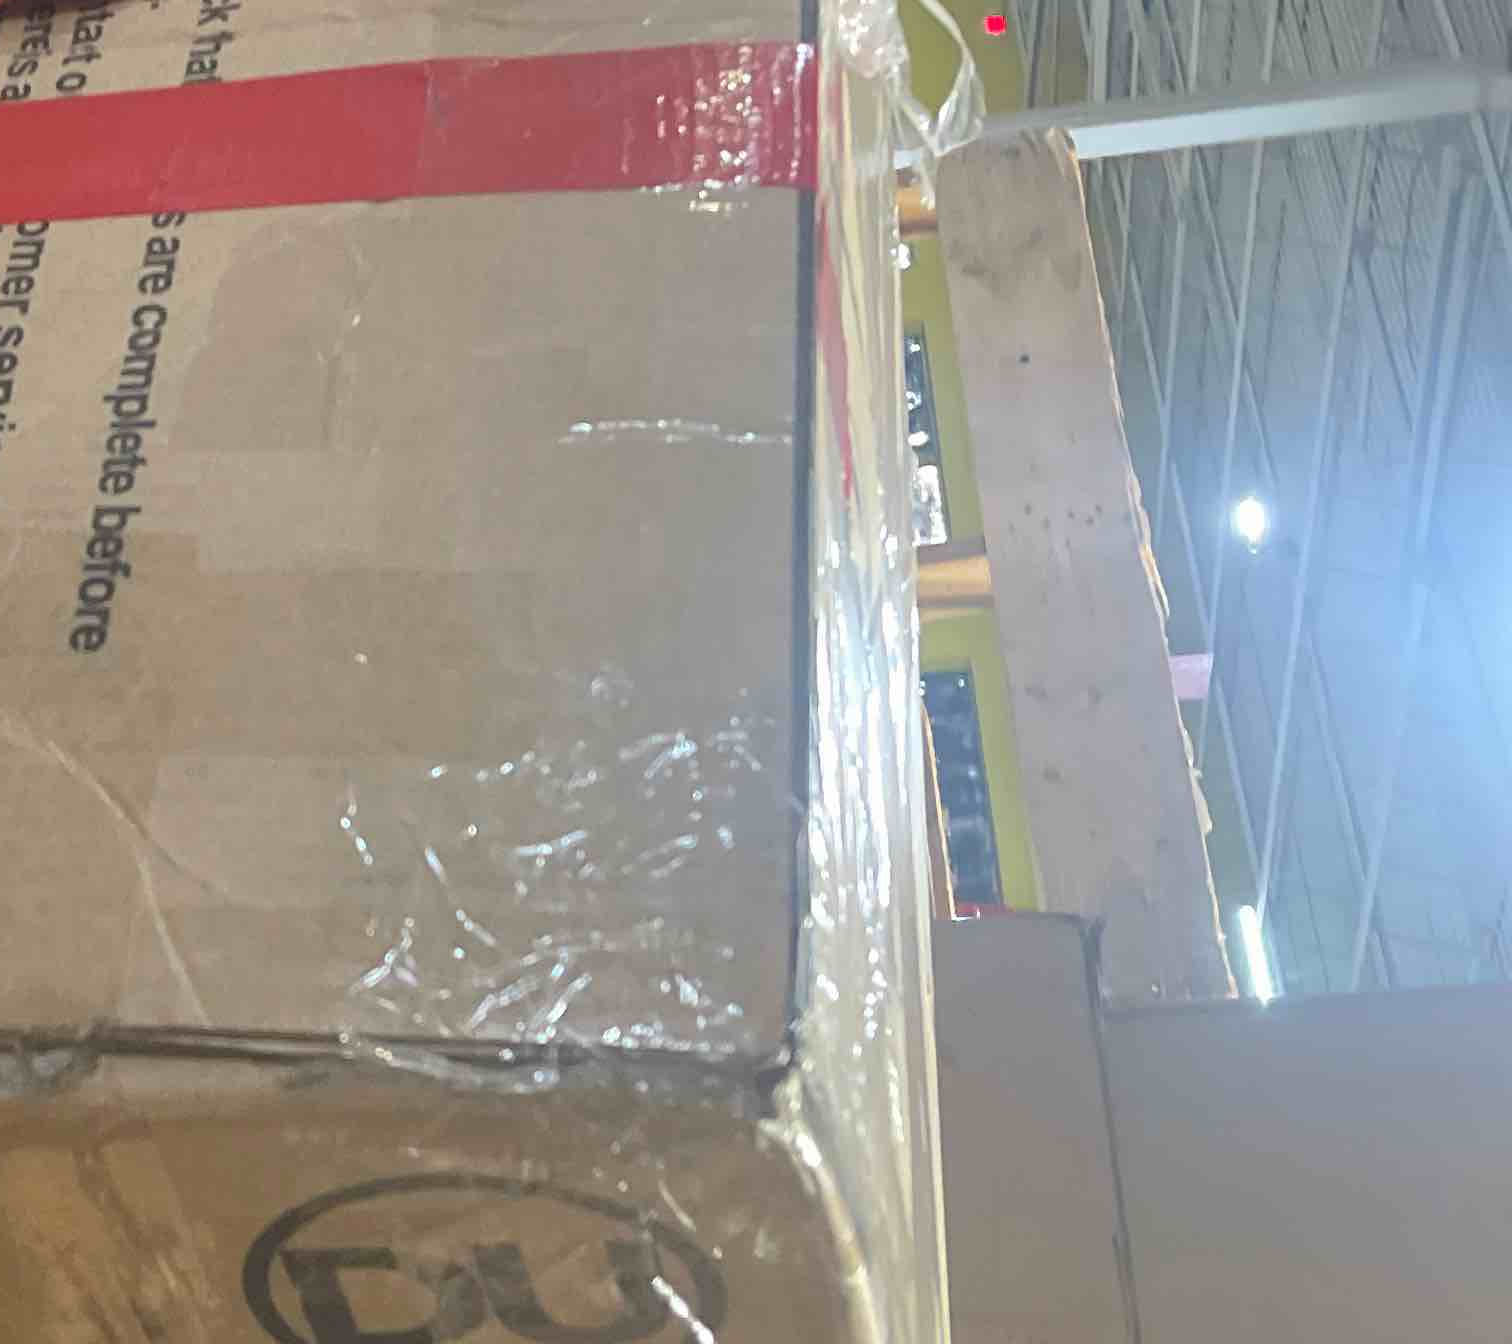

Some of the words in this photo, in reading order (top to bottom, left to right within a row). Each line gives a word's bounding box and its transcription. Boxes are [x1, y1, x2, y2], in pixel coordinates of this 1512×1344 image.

[136, 237, 181, 295] are
[97, 304, 169, 497] complete
[68, 505, 143, 654] before
